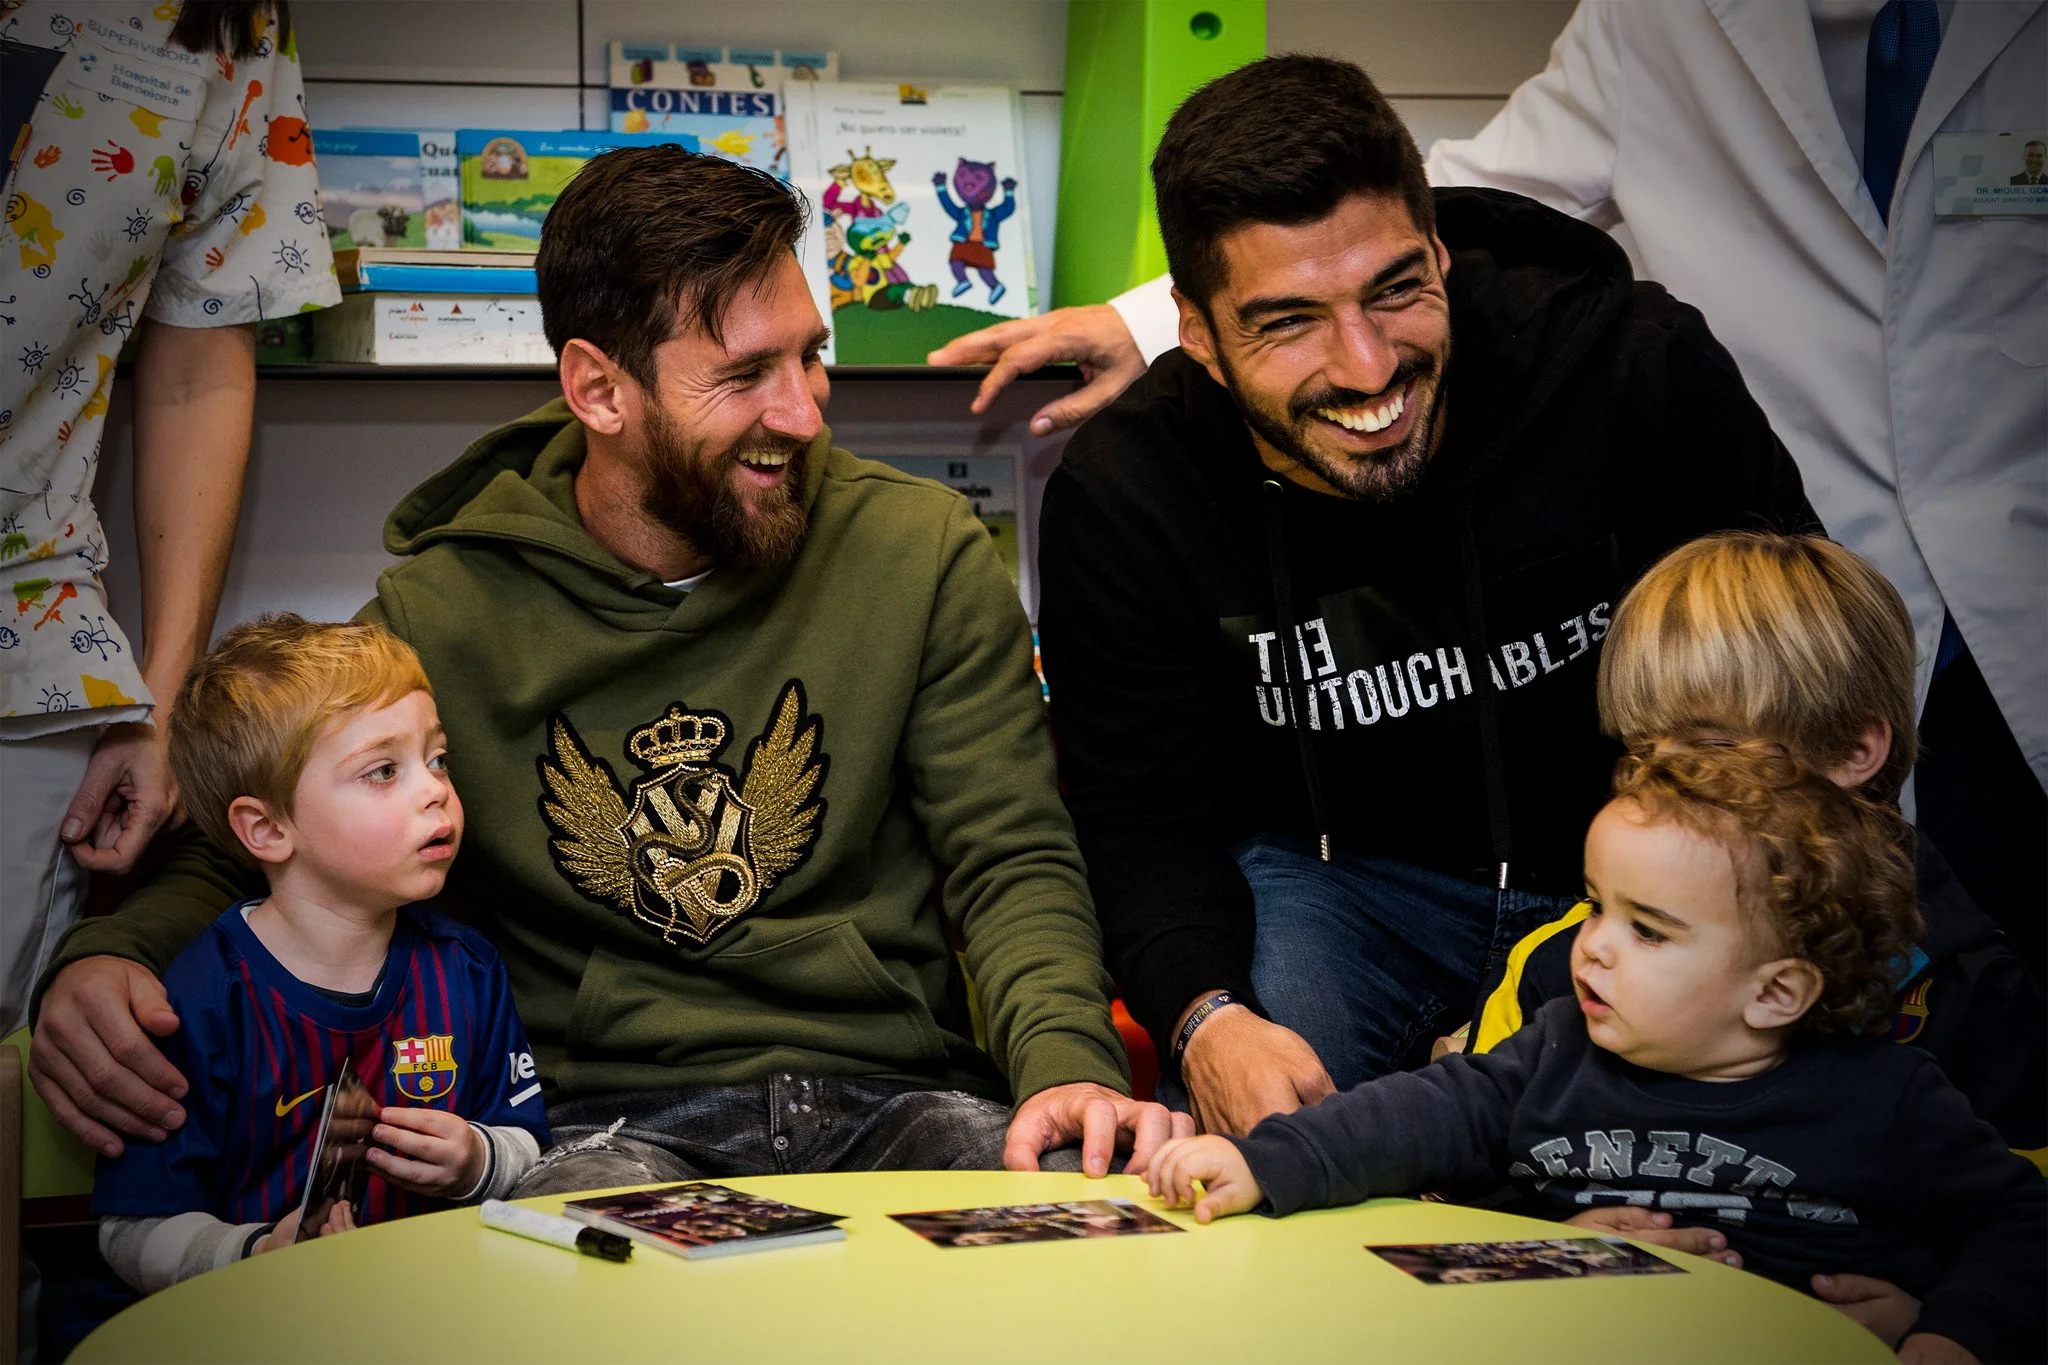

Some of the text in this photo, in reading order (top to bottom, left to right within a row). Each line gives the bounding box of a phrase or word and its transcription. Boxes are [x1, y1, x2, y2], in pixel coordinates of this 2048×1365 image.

[87, 19, 201, 67] SUPERVISORA
[111, 75, 180, 106] Barcelona
[113, 63, 192, 97] Hospital de
[626, 91, 771, 117] CONTES
[1993, 187, 2027, 195] MIQUEL
[1183, 1001, 1215, 1039] SUPERPAPA
[413, 1062, 438, 1071] FCB
